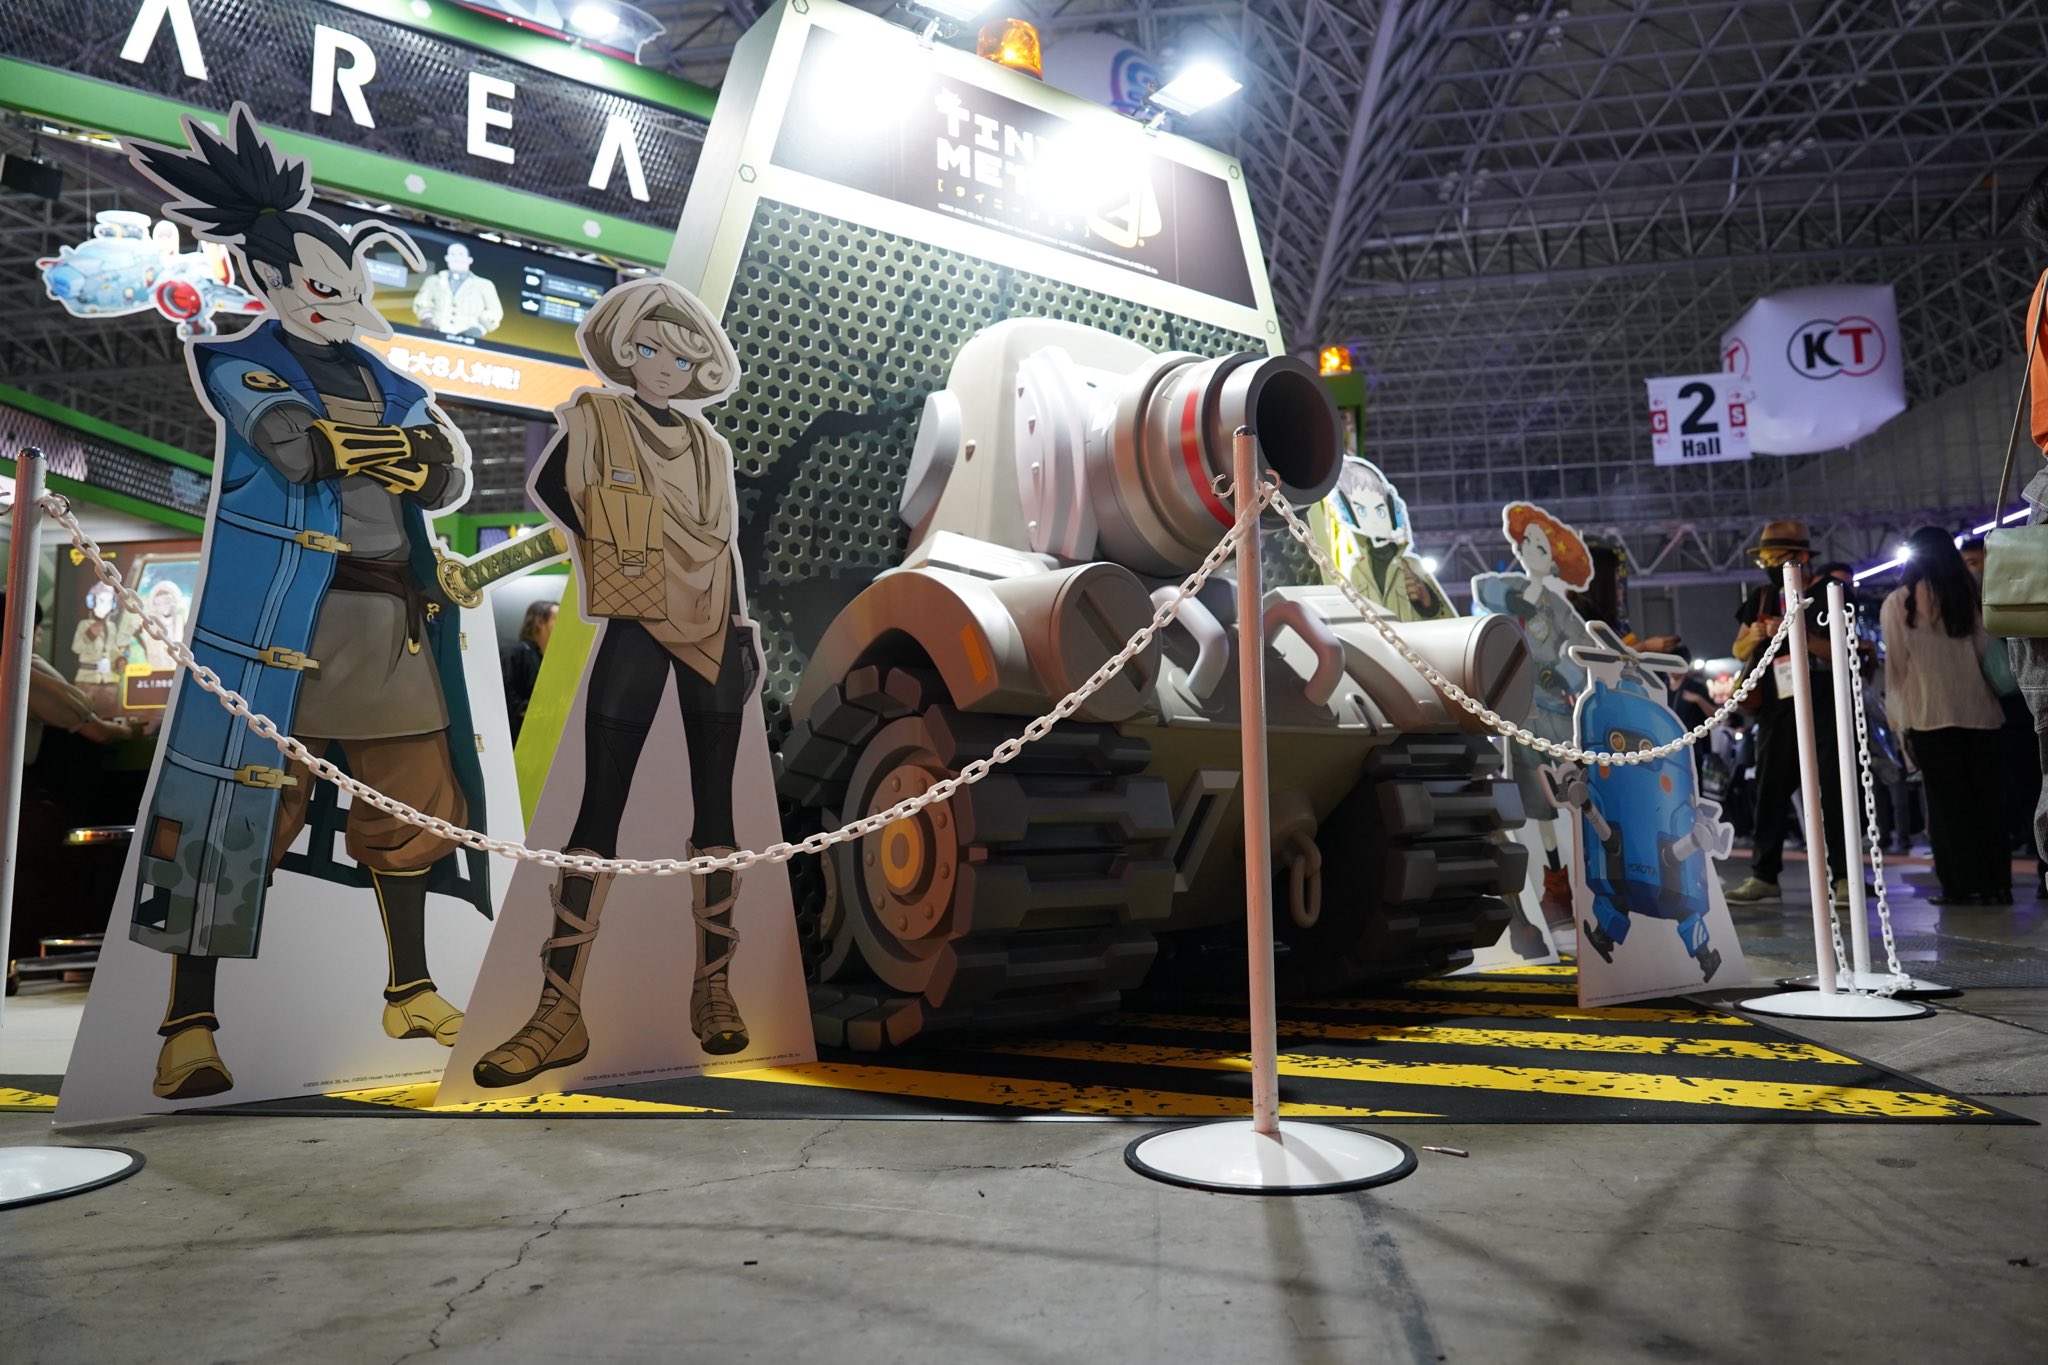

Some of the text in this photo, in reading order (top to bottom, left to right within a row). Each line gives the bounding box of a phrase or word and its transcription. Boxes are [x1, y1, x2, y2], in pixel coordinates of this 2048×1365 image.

[120, 0, 650, 202] AREA
[1803, 327, 1873, 369] KT
[1652, 412, 1667, 431] C
[1677, 382, 1719, 435] 2
[1731, 405, 1745, 425] S
[1681, 437, 1722, 458] Hall
